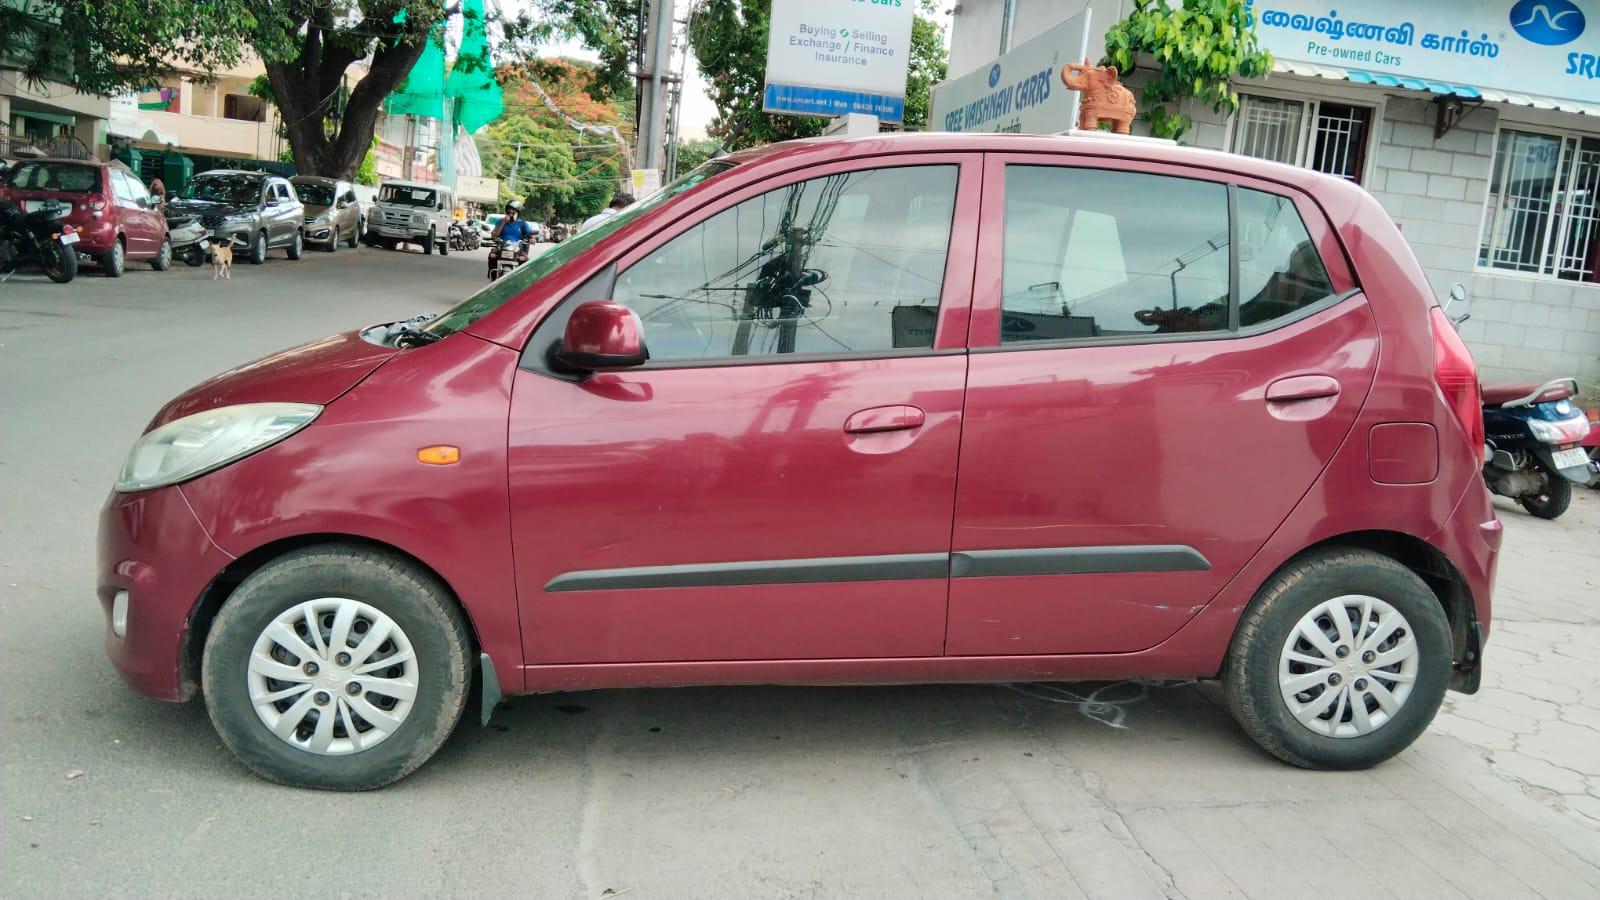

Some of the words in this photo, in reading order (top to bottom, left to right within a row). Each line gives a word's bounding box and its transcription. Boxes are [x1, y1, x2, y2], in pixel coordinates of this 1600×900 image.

[799, 24, 837, 39] Buying
[852, 29, 887, 45] Selling
[1262, 9, 1414, 47] வைஷ்ணவி
[1421, 29, 1499, 59] கார்ஸ்
[789, 36, 842, 51] Exchange
[854, 43, 895, 56] Finance
[1307, 41, 1371, 63] Pre-owned
[1375, 50, 1402, 67] Cars
[815, 51, 868, 66] Insurance
[945, 106, 964, 133] SREE
[964, 84, 1014, 130] VAISHNAVI
[1015, 66, 1053, 112] CARRS
